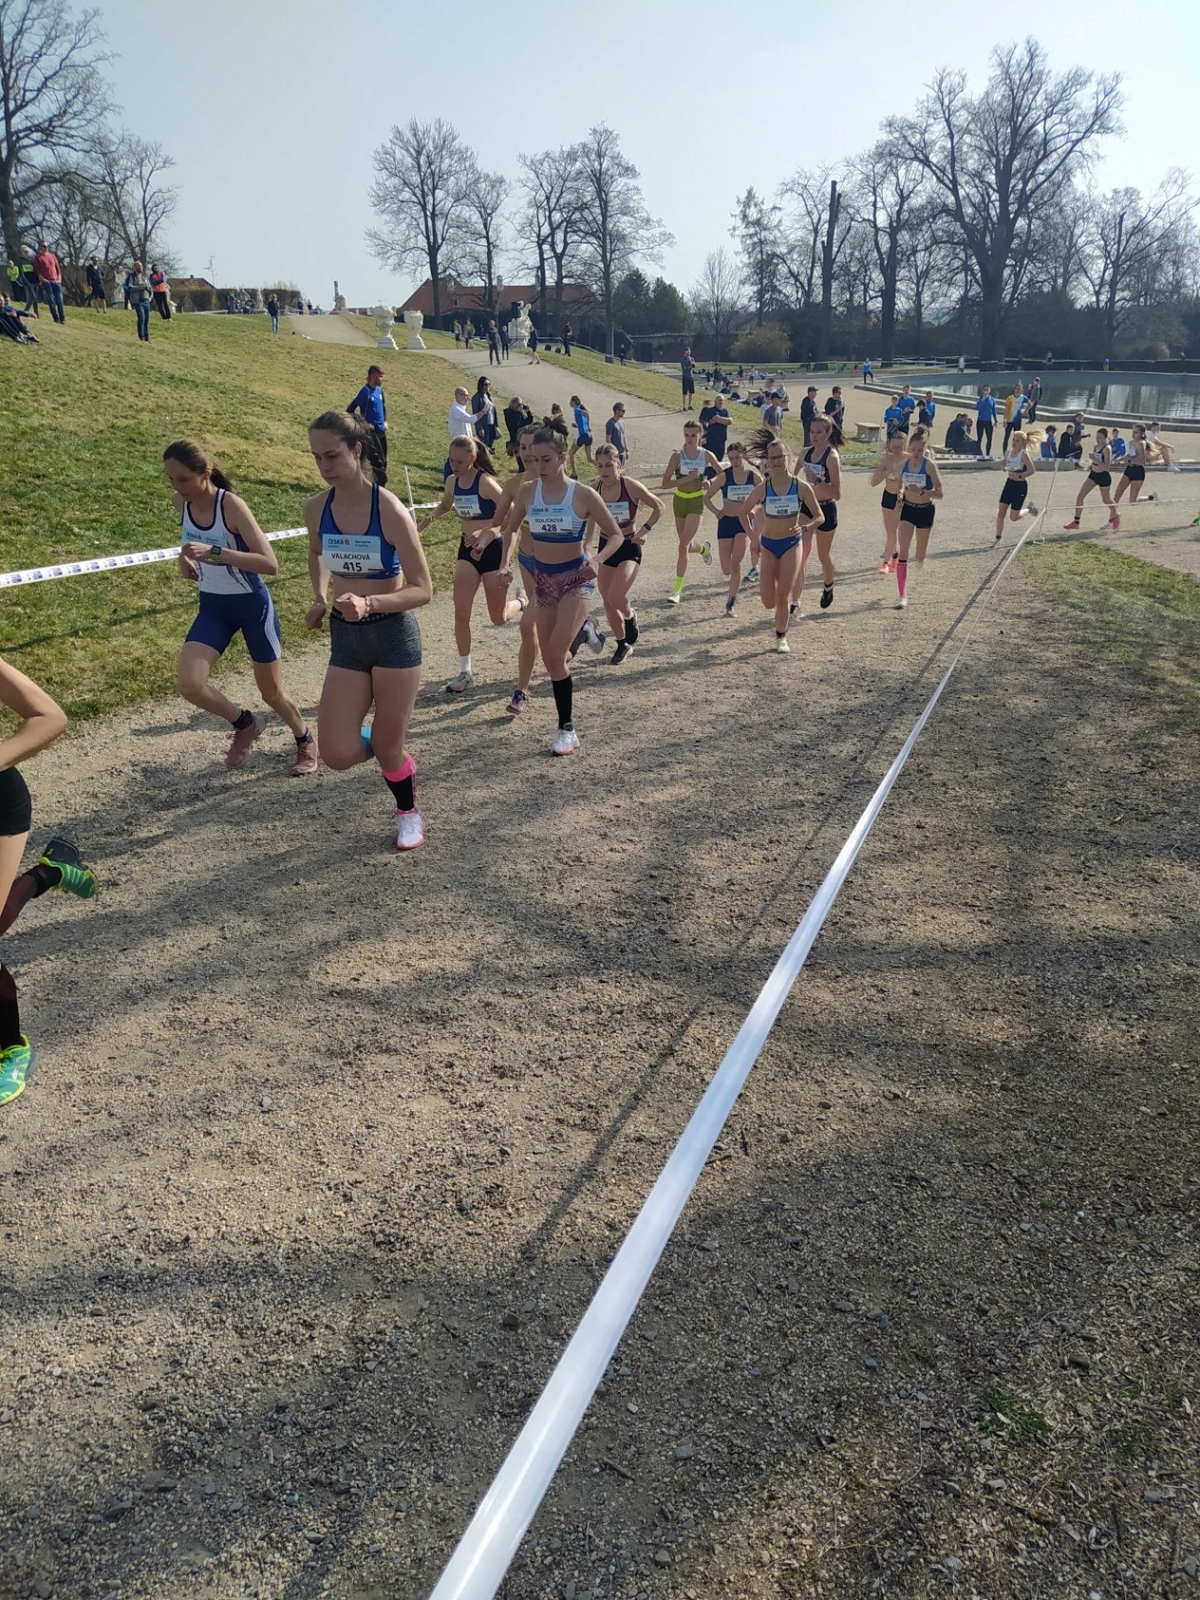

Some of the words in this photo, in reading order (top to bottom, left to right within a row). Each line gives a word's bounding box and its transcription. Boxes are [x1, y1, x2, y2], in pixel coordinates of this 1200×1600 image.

[541, 524, 557, 532] 428
[328, 537, 344, 545] ČESKÁ
[331, 552, 371, 560] VALACHOVÁ
[343, 562, 362, 572] 415
